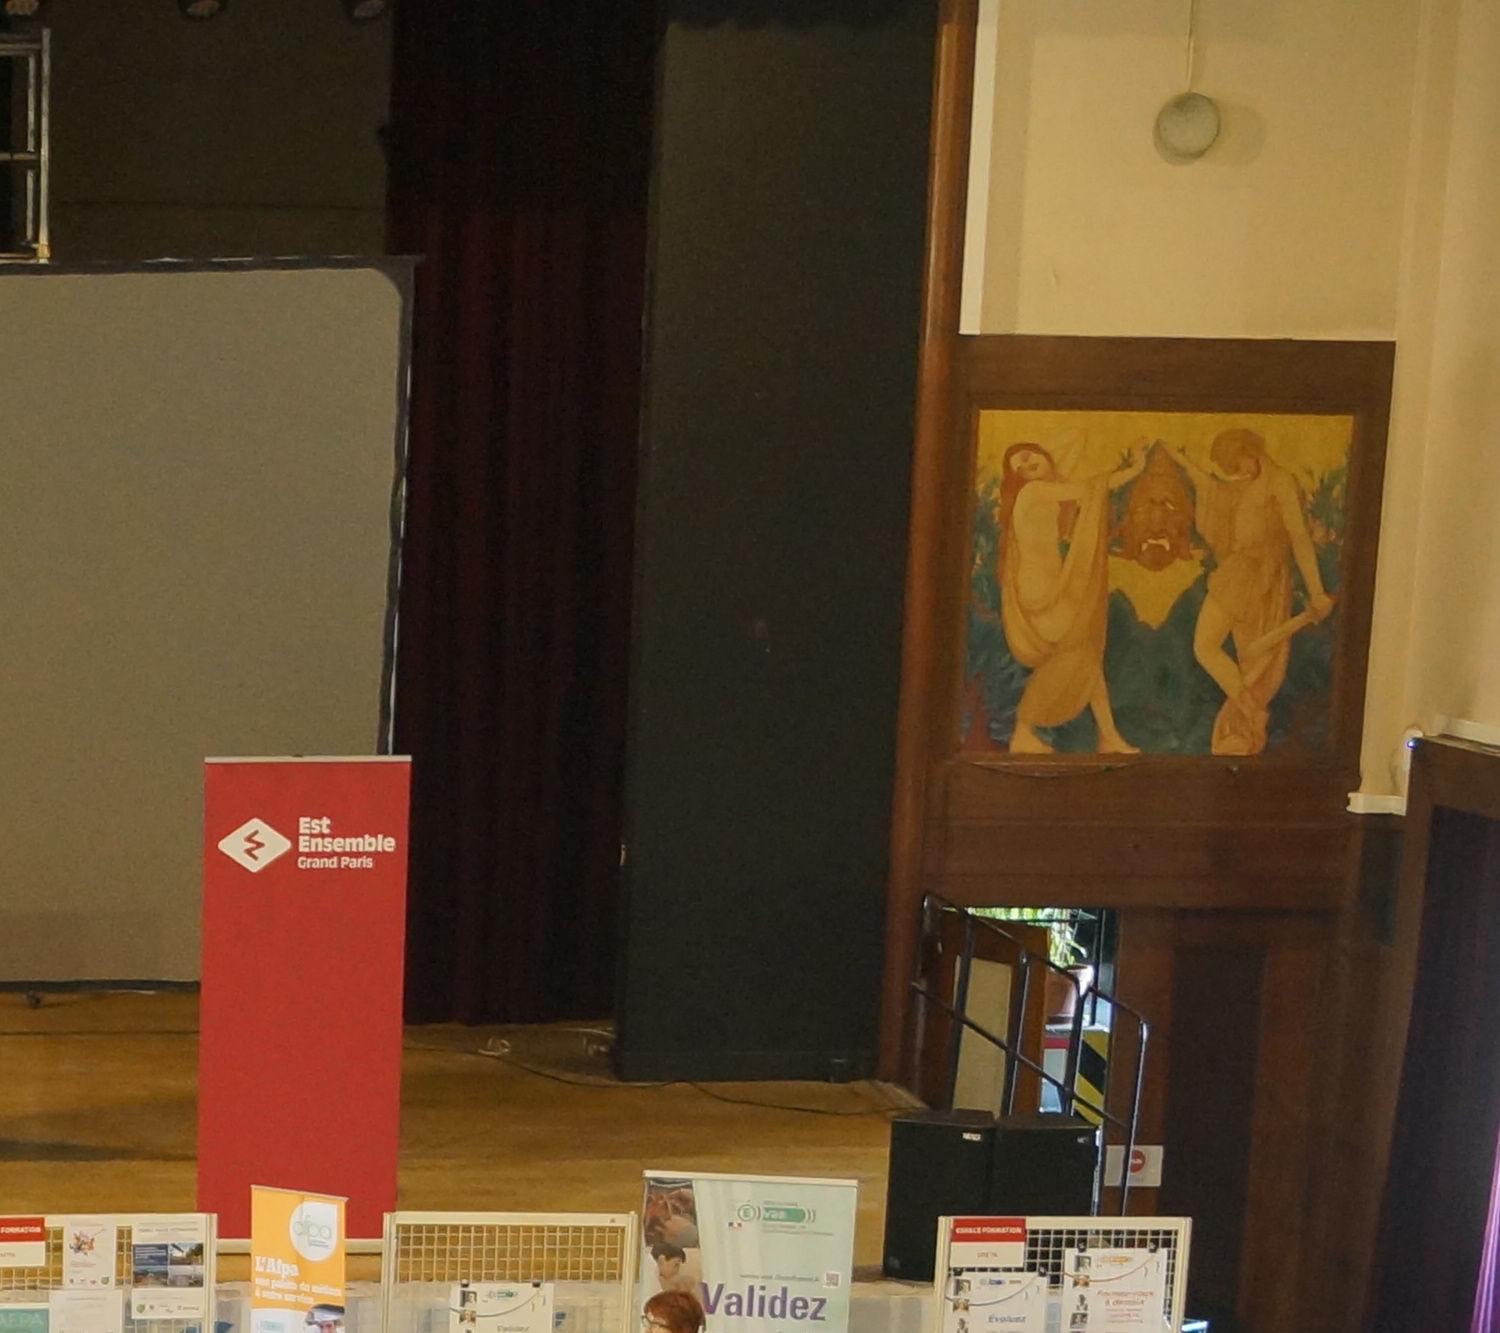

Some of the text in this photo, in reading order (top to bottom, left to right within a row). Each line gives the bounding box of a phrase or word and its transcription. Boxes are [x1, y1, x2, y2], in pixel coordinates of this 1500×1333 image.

[298, 816, 331, 834] Est
[297, 833, 396, 853] Ensemble
[297, 855, 373, 869] Grand Paris
[699, 1282, 828, 1321] Validez
